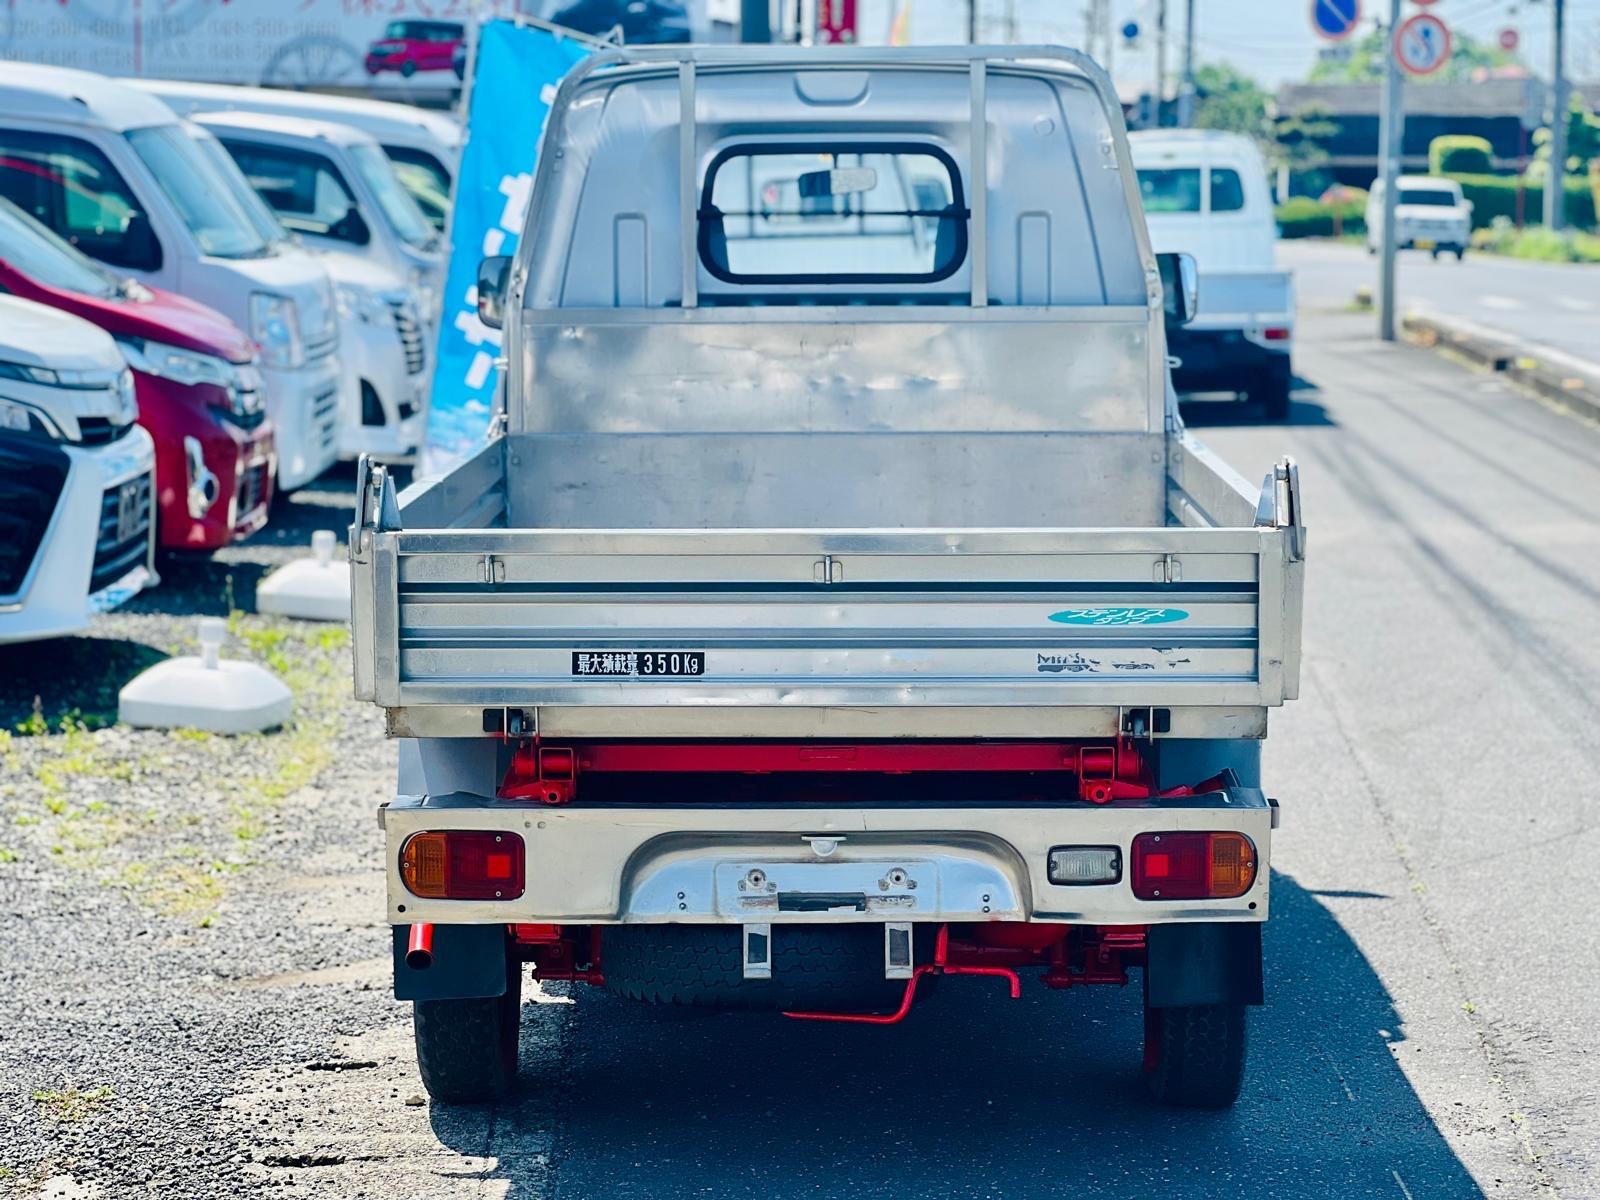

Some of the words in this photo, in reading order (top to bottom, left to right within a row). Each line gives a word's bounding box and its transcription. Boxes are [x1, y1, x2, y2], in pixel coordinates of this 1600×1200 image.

[577, 653, 639, 675] 最大積載量
[643, 653, 699, 674] 350Kg
